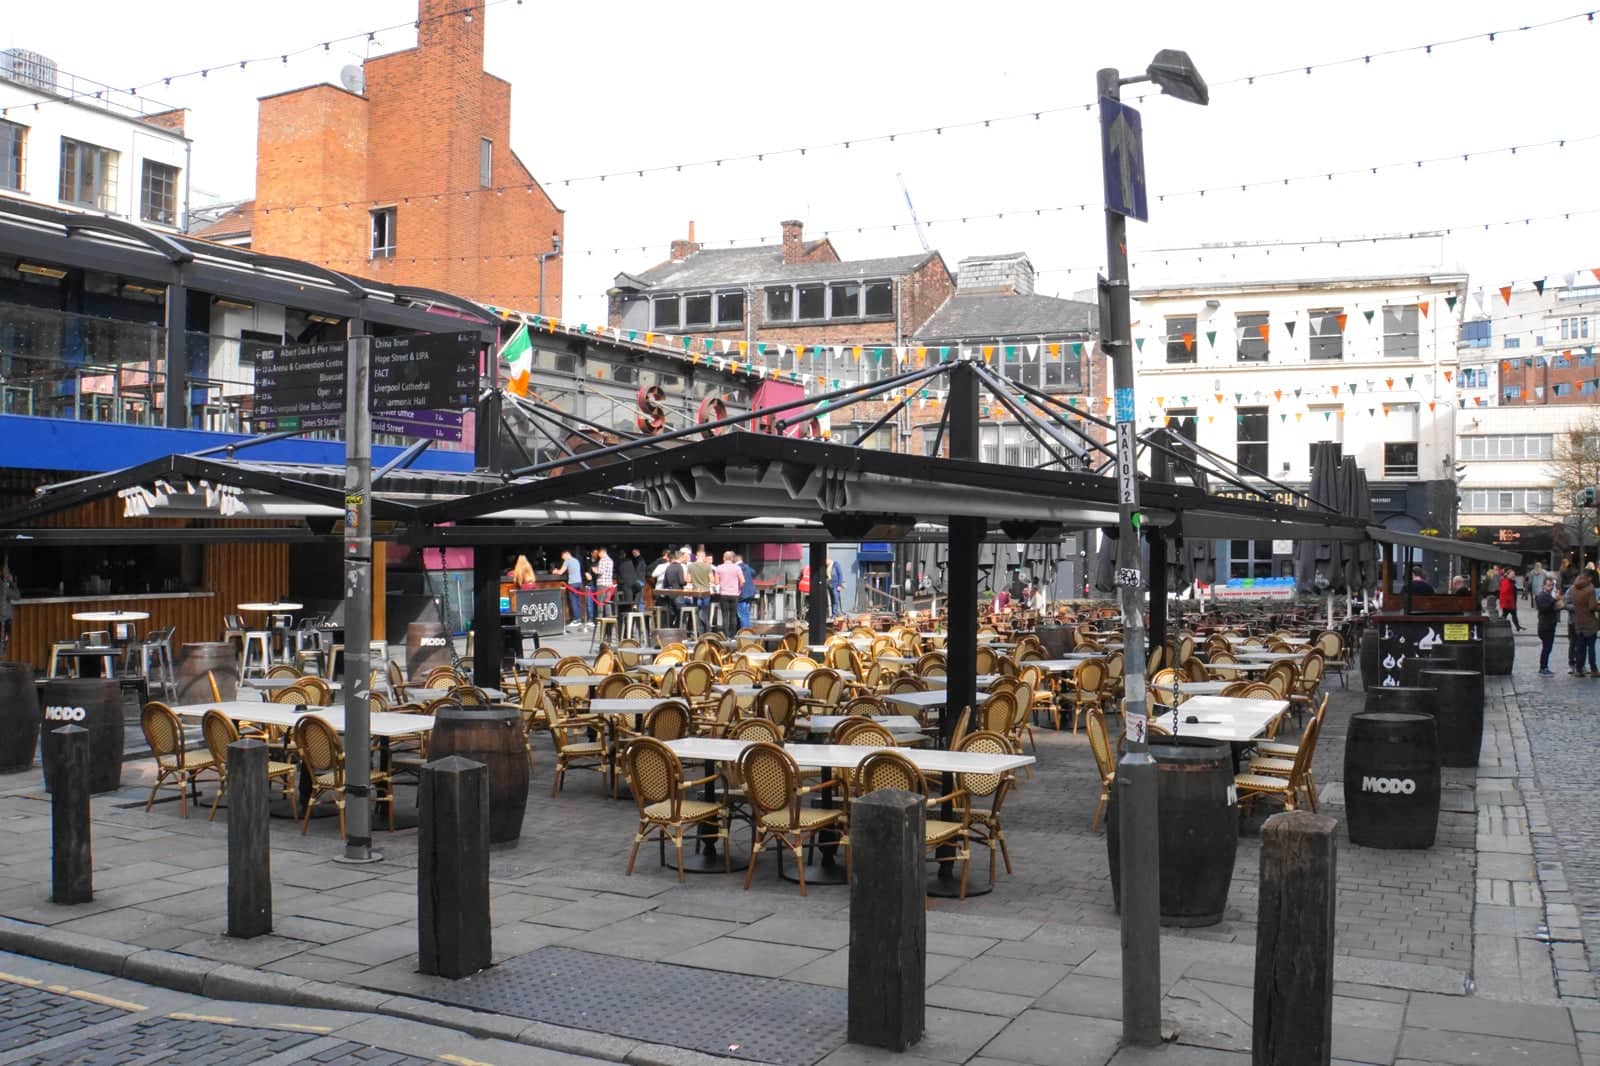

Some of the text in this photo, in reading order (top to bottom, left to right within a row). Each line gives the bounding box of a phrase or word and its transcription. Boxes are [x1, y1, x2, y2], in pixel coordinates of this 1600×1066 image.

[375, 338, 392, 349] China
[281, 347, 297, 357] Albert
[312, 345, 317, 355] &
[374, 351, 430, 364] Hope Street & LIPA
[272, 363, 289, 373] Arena
[289, 362, 294, 371] &
[294, 360, 325, 371] Convention
[325, 359, 344, 368] Centre
[319, 373, 344, 382] Bluecoat
[374, 368, 390, 377] FACT
[374, 380, 431, 394] Liverpool Cathedral
[413, 396, 427, 406] Hall
[371, 422, 404, 433] Bold Street
[1120, 424, 1132, 503] XA1072
[521, 602, 559, 623] SOHO
[420, 637, 447, 647] MODO
[44, 705, 86, 722] MODO
[1361, 775, 1417, 795] MODO
